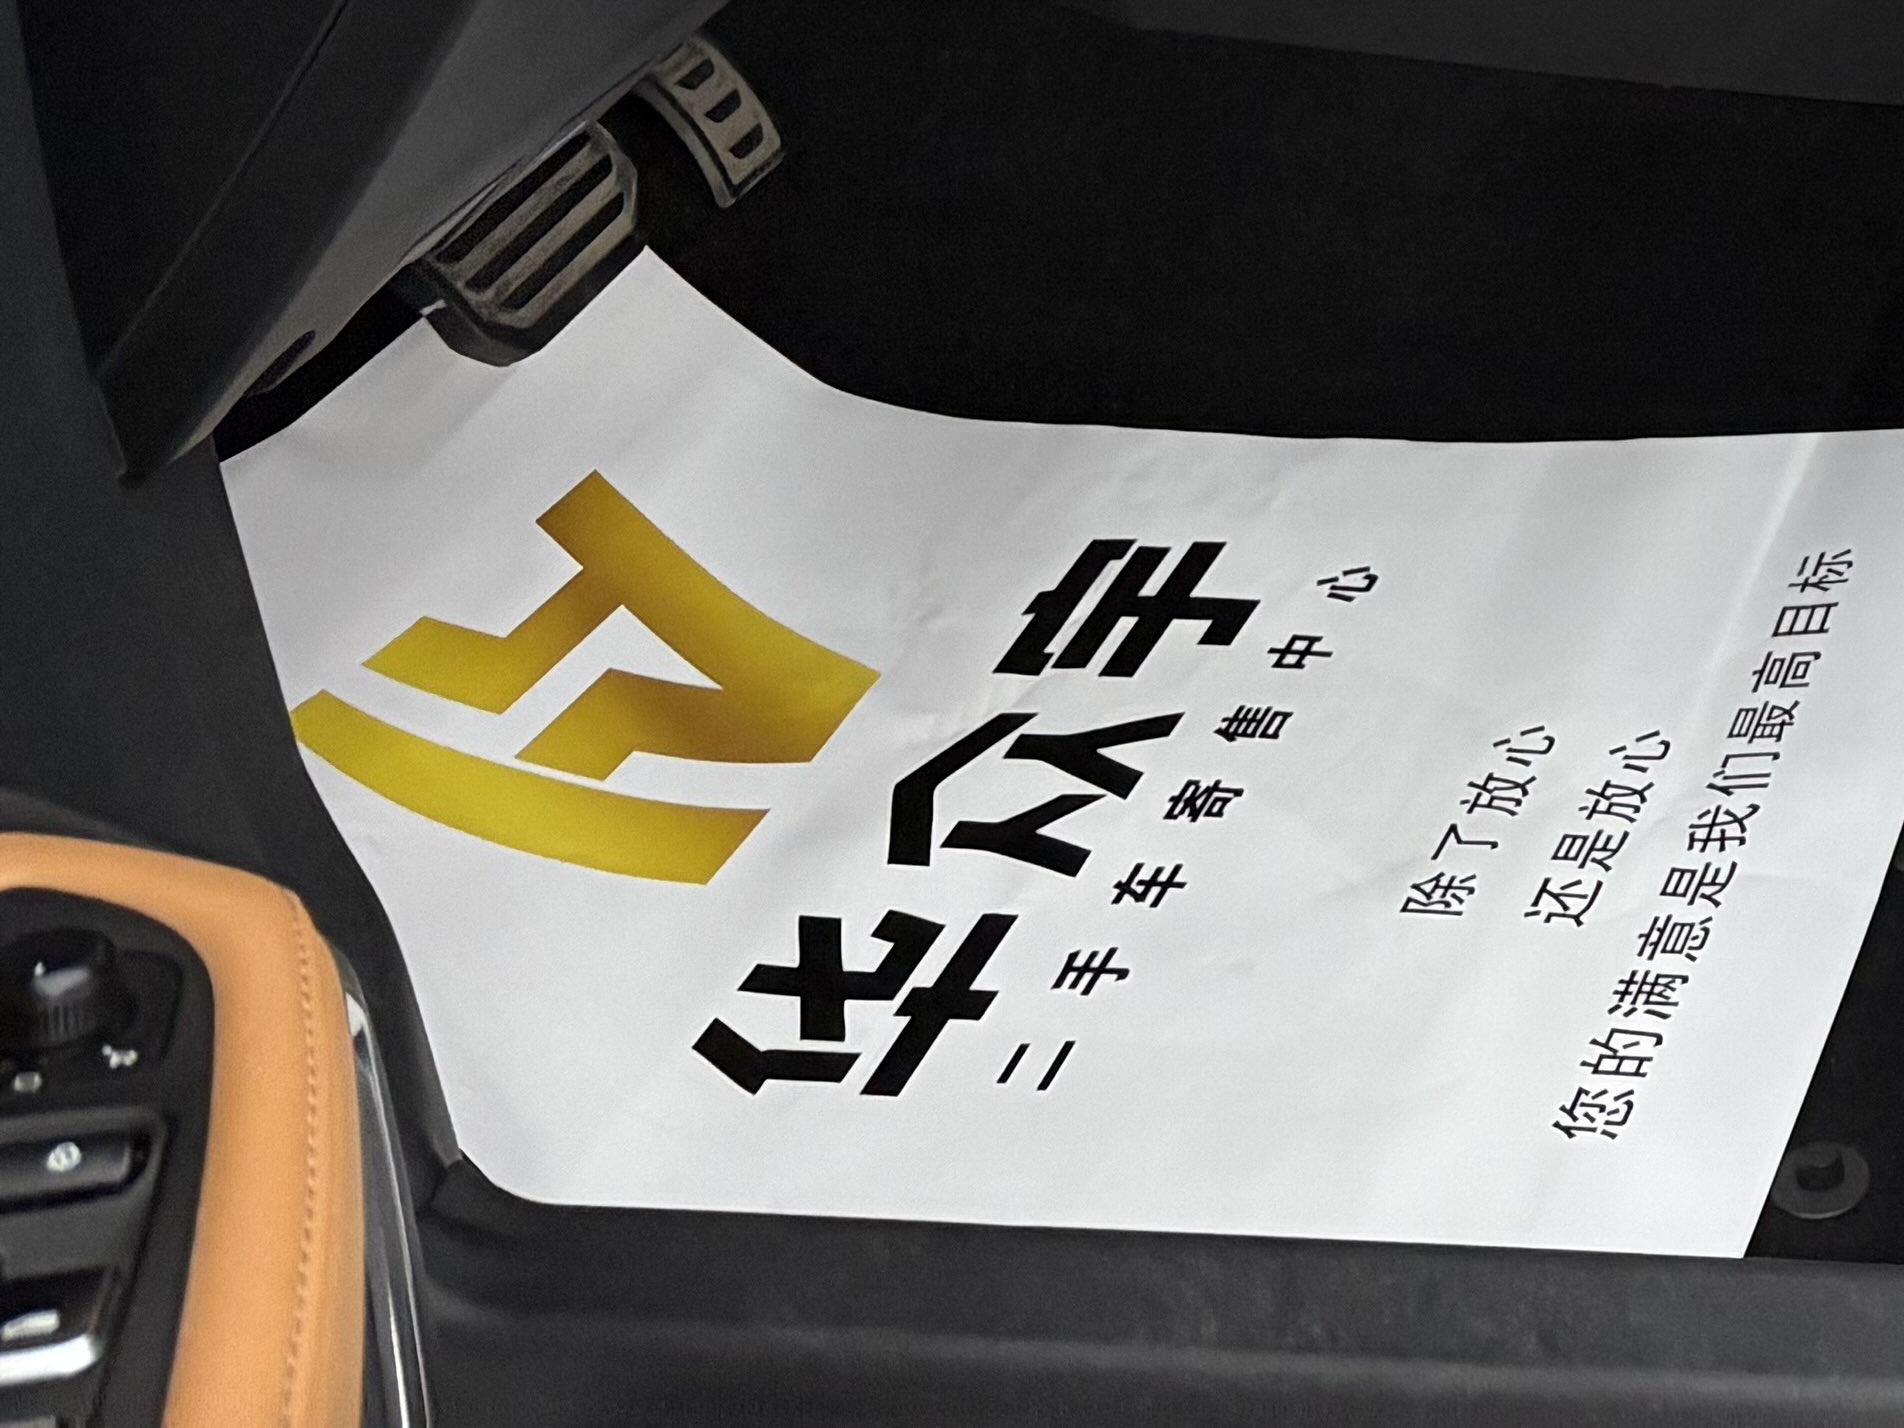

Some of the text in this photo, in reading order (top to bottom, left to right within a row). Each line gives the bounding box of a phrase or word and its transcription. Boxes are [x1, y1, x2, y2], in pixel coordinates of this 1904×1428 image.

[690, 538, 1260, 1097] 华众宇
[996, 564, 1379, 1091] 二手车寄售中心
[1400, 724, 1556, 918] 除了放心
[1523, 729, 1671, 927] 还是放心
[1551, 547, 1855, 1140] 您的满意是我们最高目标
